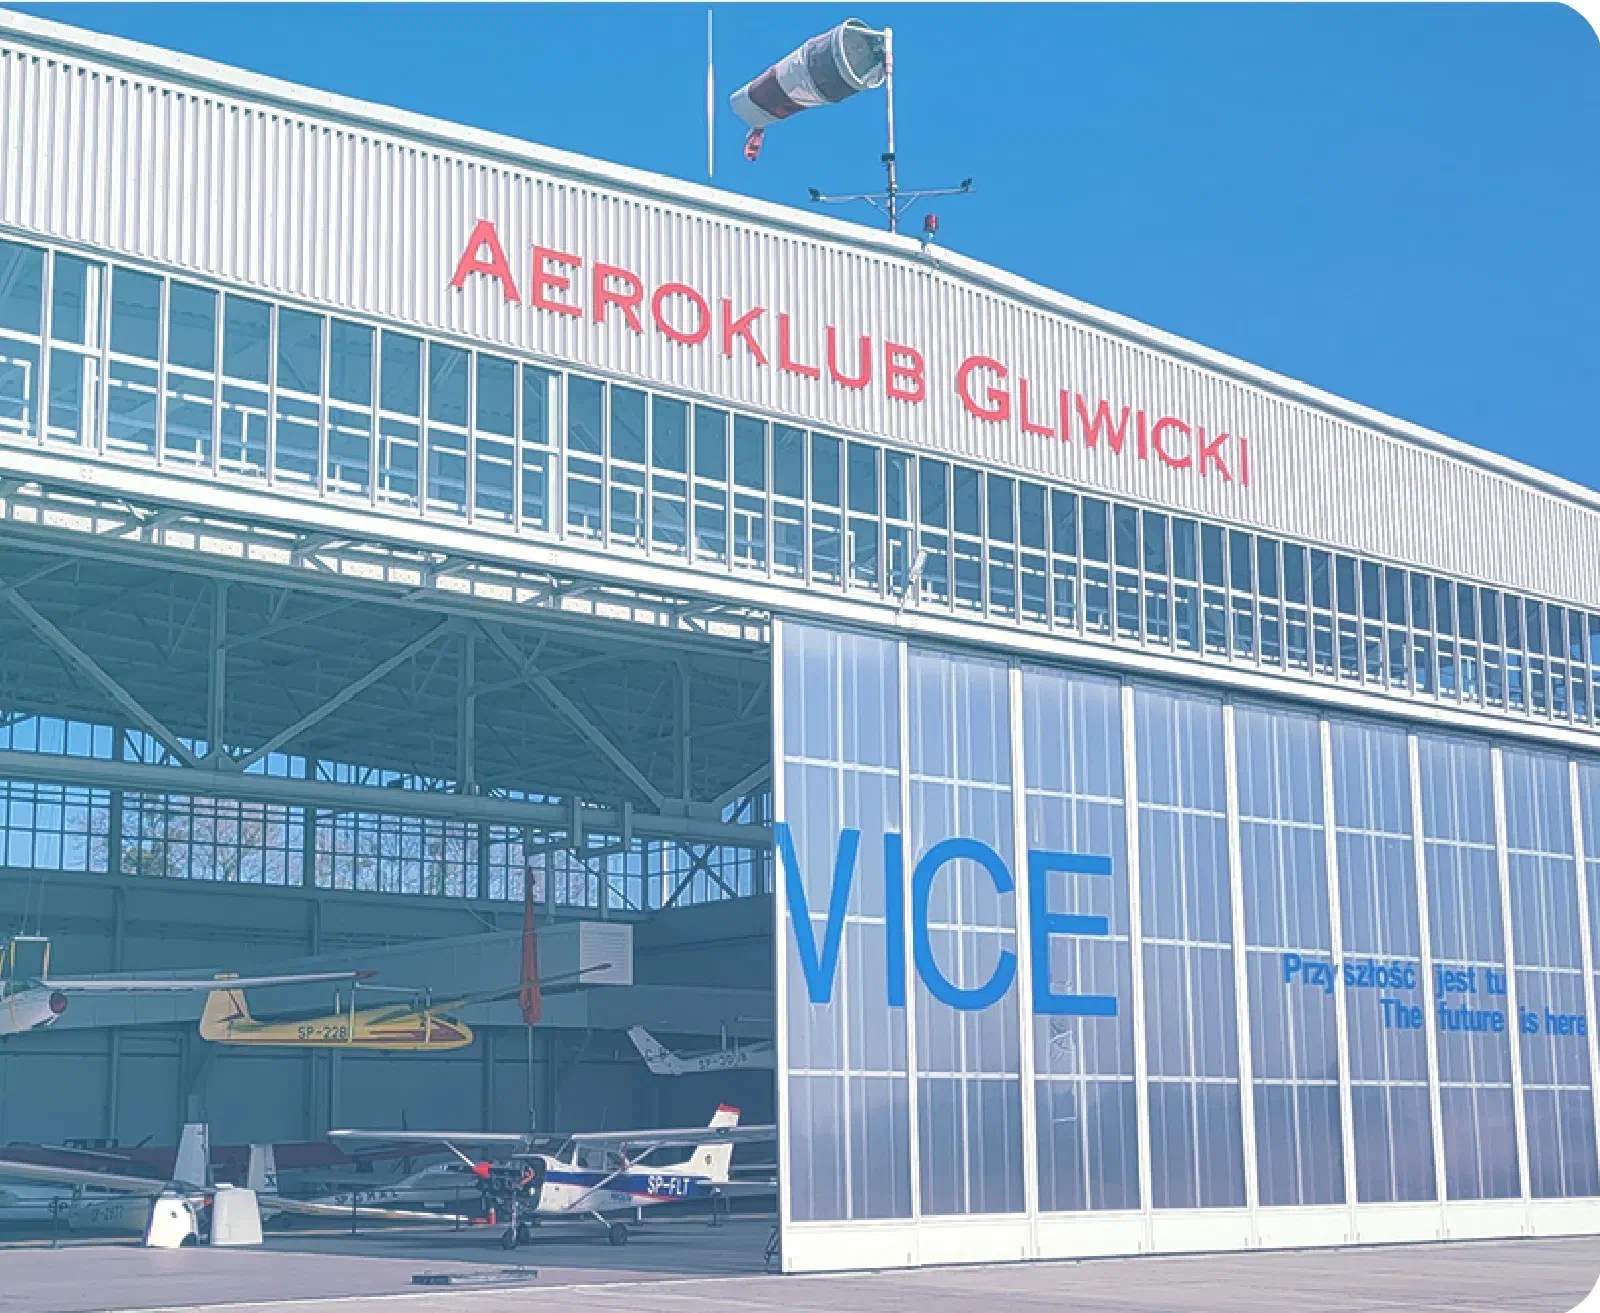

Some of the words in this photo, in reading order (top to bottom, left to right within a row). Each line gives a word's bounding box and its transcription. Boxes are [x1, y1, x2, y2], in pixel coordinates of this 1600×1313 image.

[448, 219, 926, 403] AEROKLUB
[957, 355, 1249, 486] GLIWICKI
[774, 821, 1118, 1016] VICE
[1436, 961, 1477, 998] jest
[1380, 998, 1424, 1030] The
[1436, 1001, 1504, 1032] future
[1519, 1006, 1539, 1034] is
[647, 1175, 690, 1196] SP-FLT
